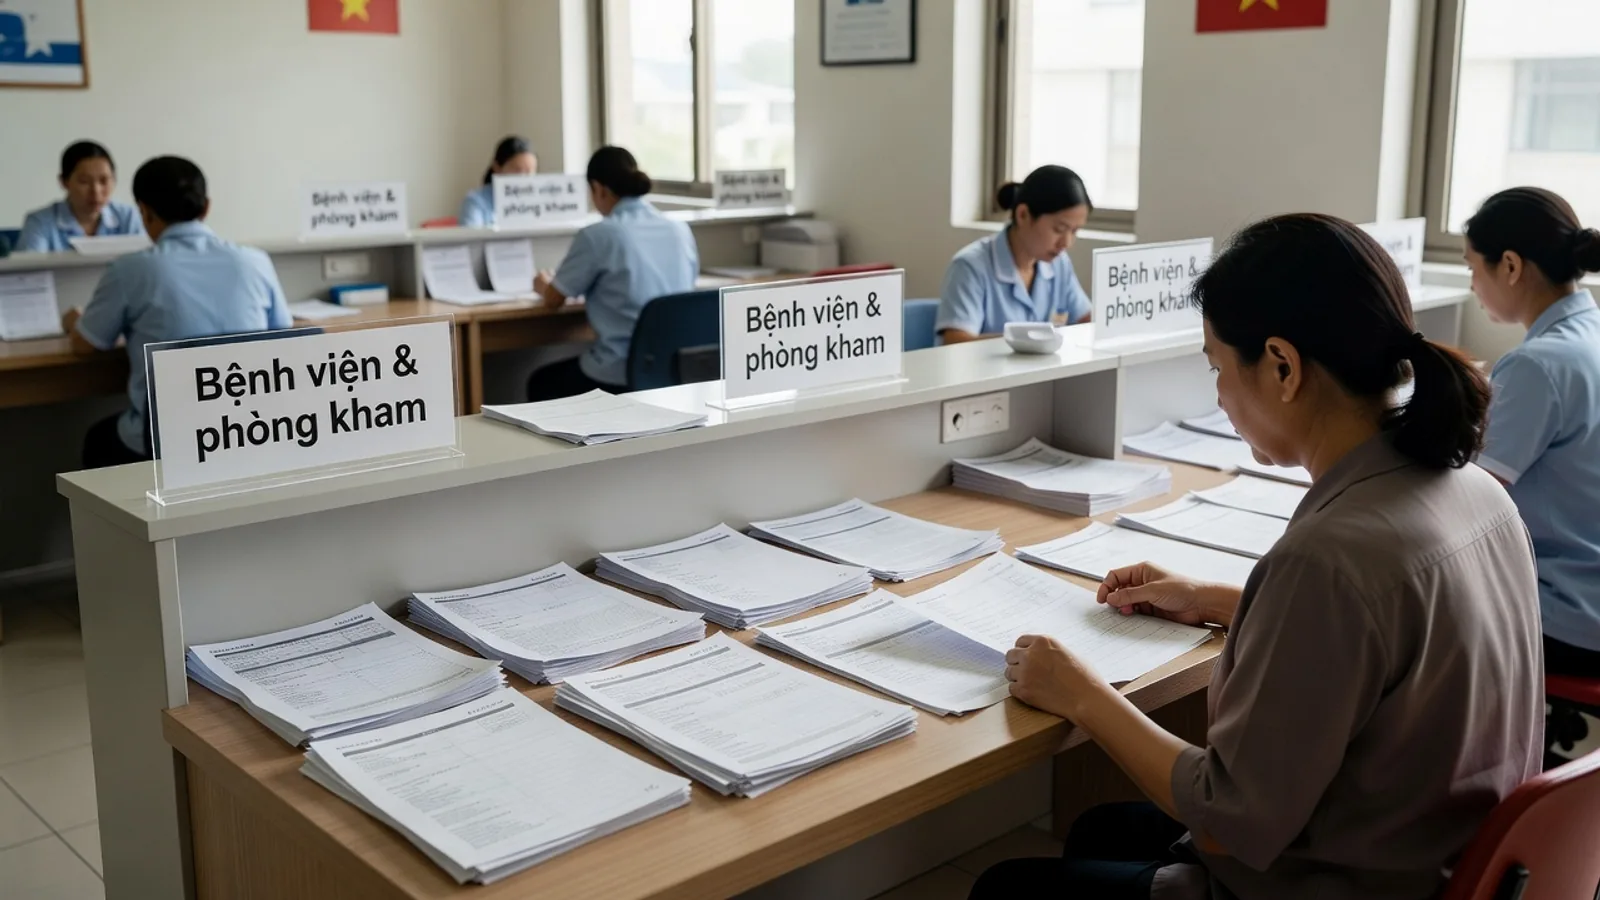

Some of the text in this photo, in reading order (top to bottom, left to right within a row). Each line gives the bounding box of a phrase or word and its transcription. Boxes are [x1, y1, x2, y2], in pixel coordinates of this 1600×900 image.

[746, 291, 882, 338] Bệnh viện &
[195, 344, 418, 406] Bệnh viện &
[746, 333, 884, 380] phòng kham
[196, 397, 426, 463] phòng kham
